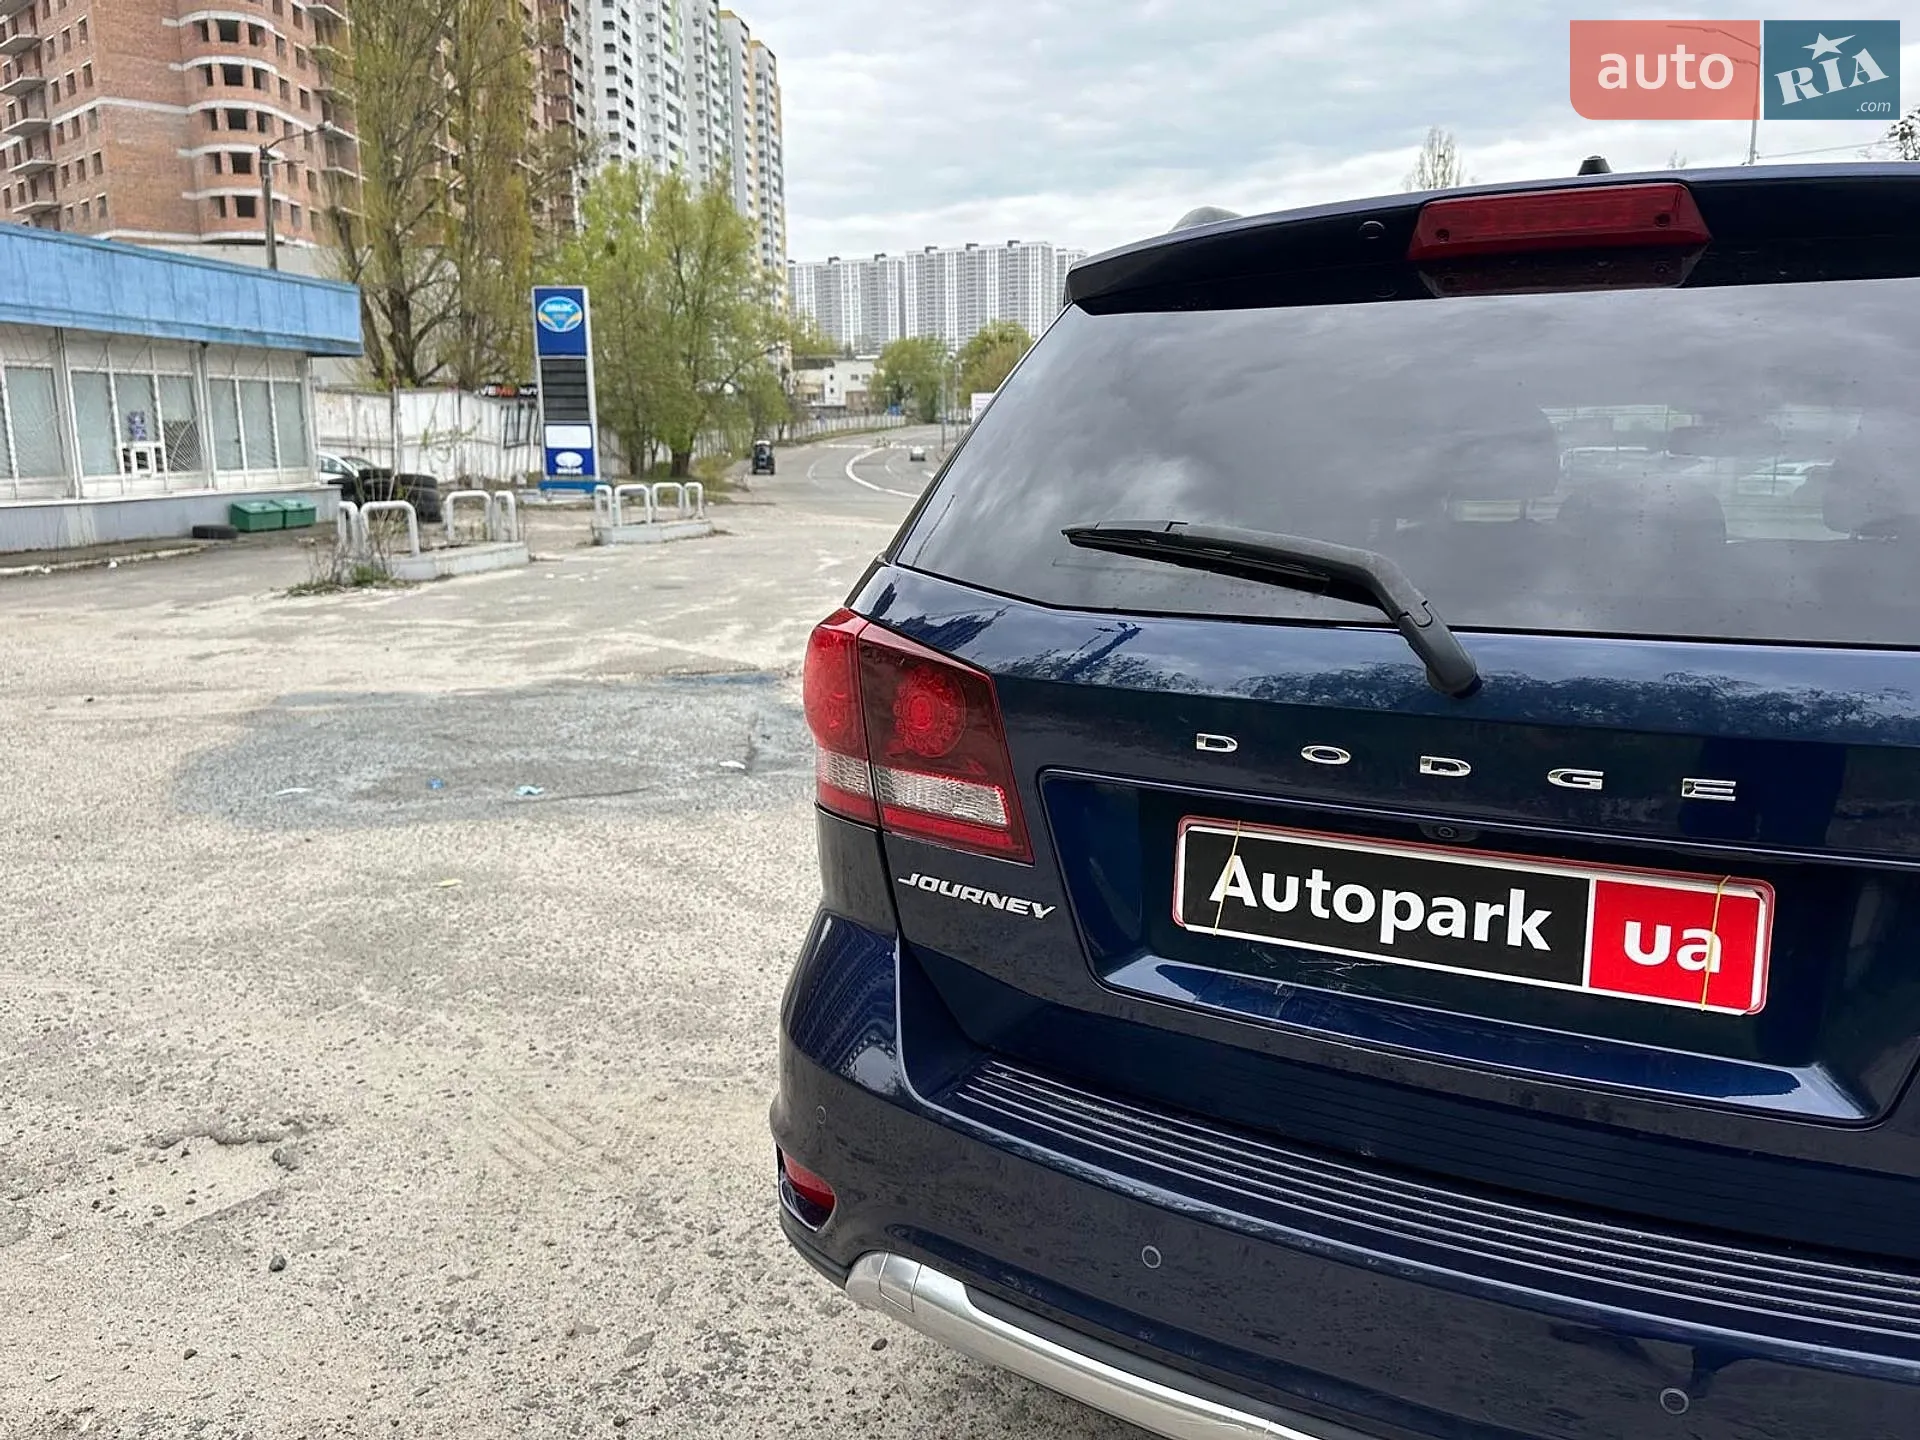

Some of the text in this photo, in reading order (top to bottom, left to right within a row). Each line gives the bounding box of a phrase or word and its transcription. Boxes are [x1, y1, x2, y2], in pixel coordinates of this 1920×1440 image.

[1196, 732, 1737, 802] DODGE
[897, 873, 1057, 919] JOURNEY
[1208, 854, 1724, 975] Autopark ua
